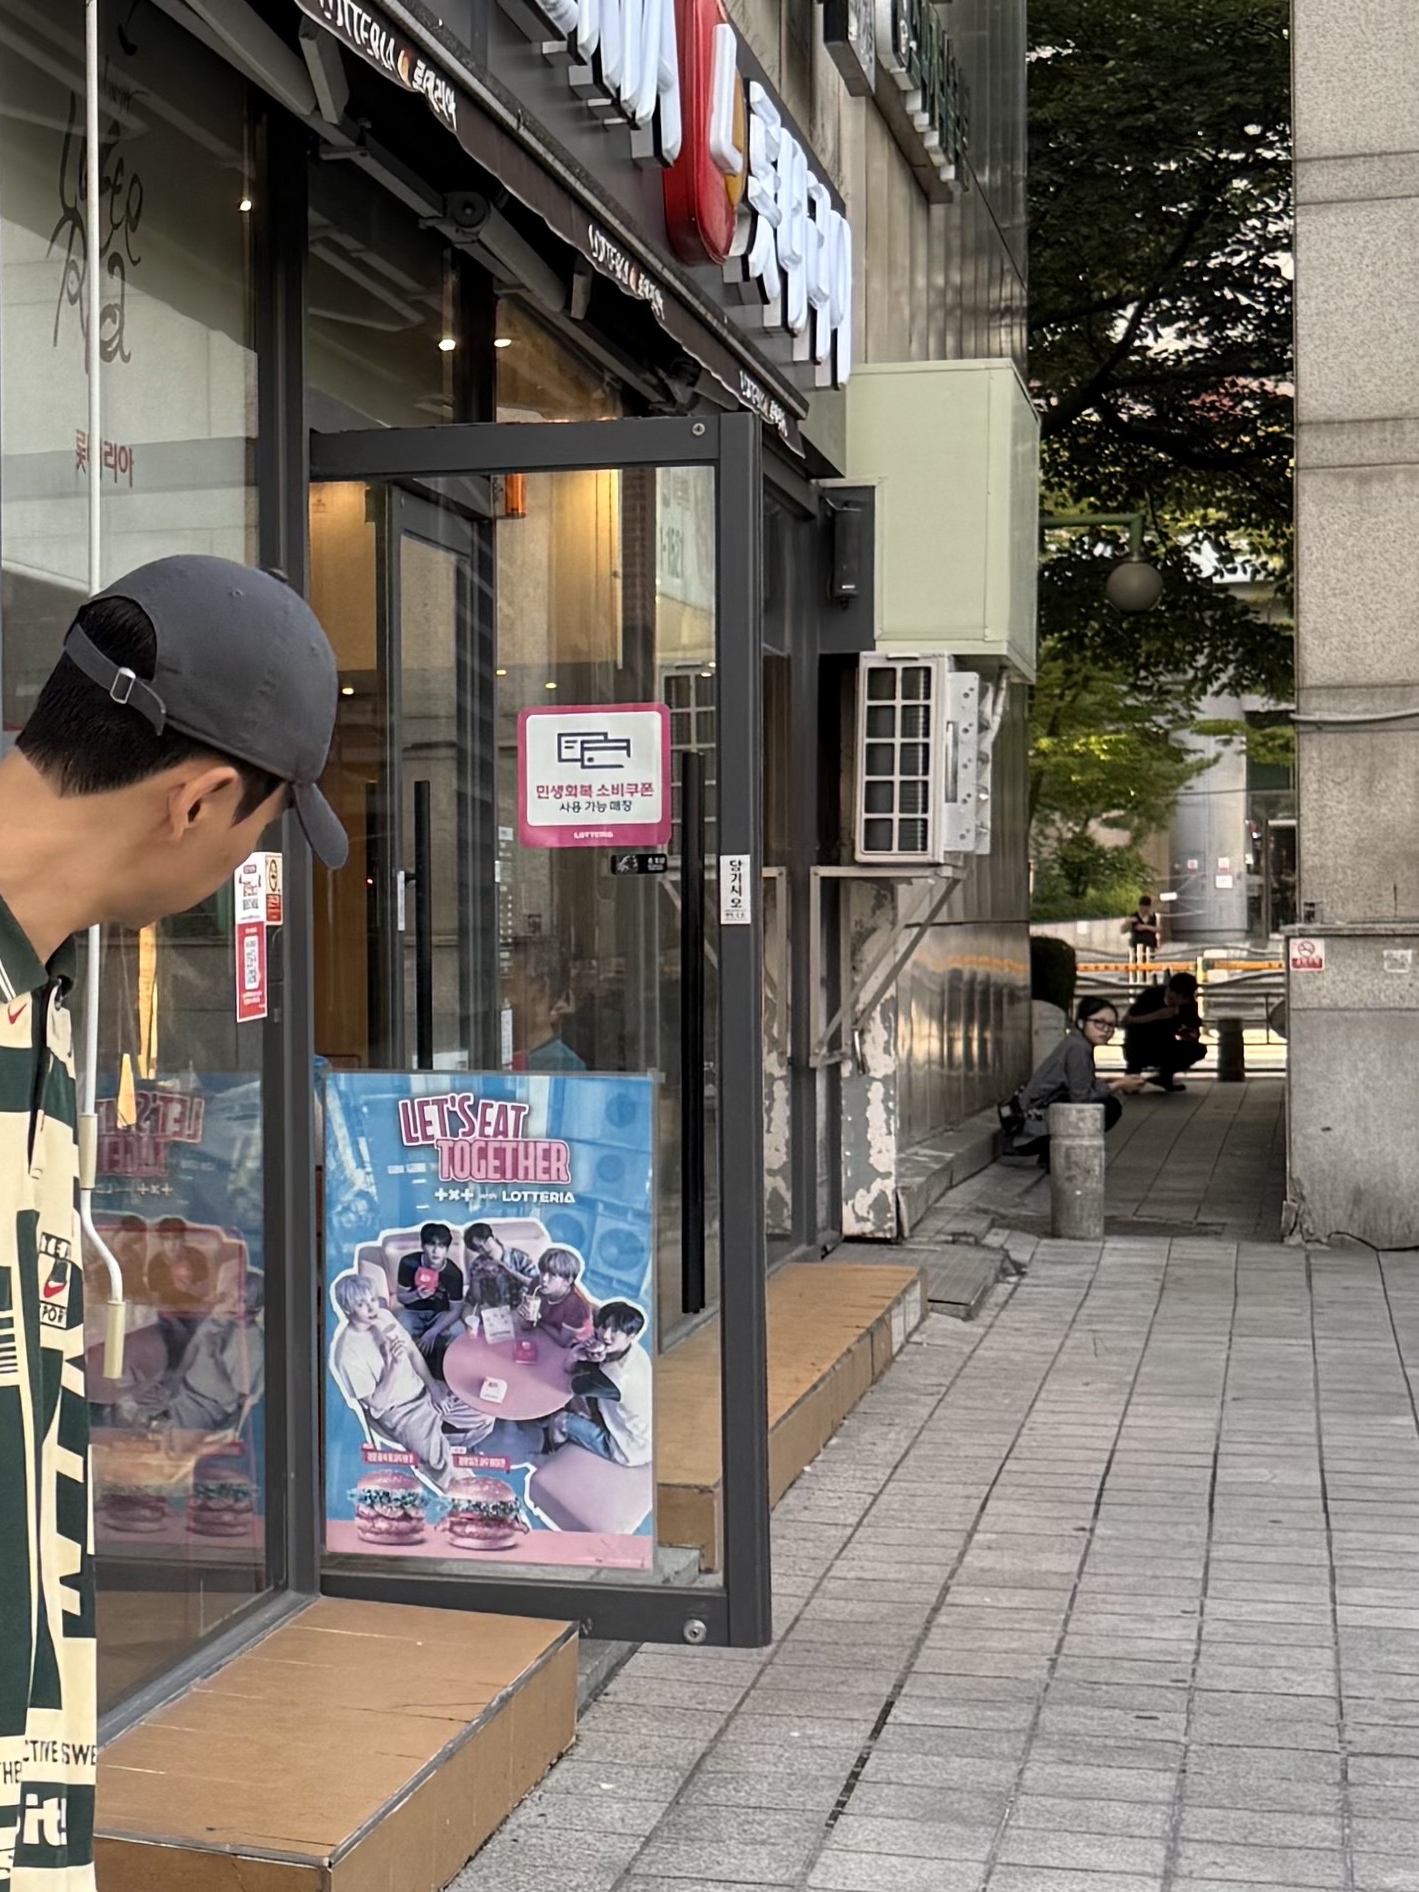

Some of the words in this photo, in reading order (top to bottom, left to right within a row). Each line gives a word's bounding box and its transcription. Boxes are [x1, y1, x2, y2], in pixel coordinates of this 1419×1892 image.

[75, 428, 133, 488] 롯리아
[536, 785, 593, 800] 민생회복
[596, 783, 654, 798] 소비쿠폰
[559, 801, 581, 813] 사용
[585, 800, 607, 813] 가능
[610, 800, 633, 812] 매장
[729, 859, 743, 908] 당기시오
[399, 1093, 477, 1146] LET'S
[478, 1100, 529, 1140] EAT
[436, 1138, 570, 1183] TOGETHER
[502, 1190, 575, 1203] LOTTERIA
